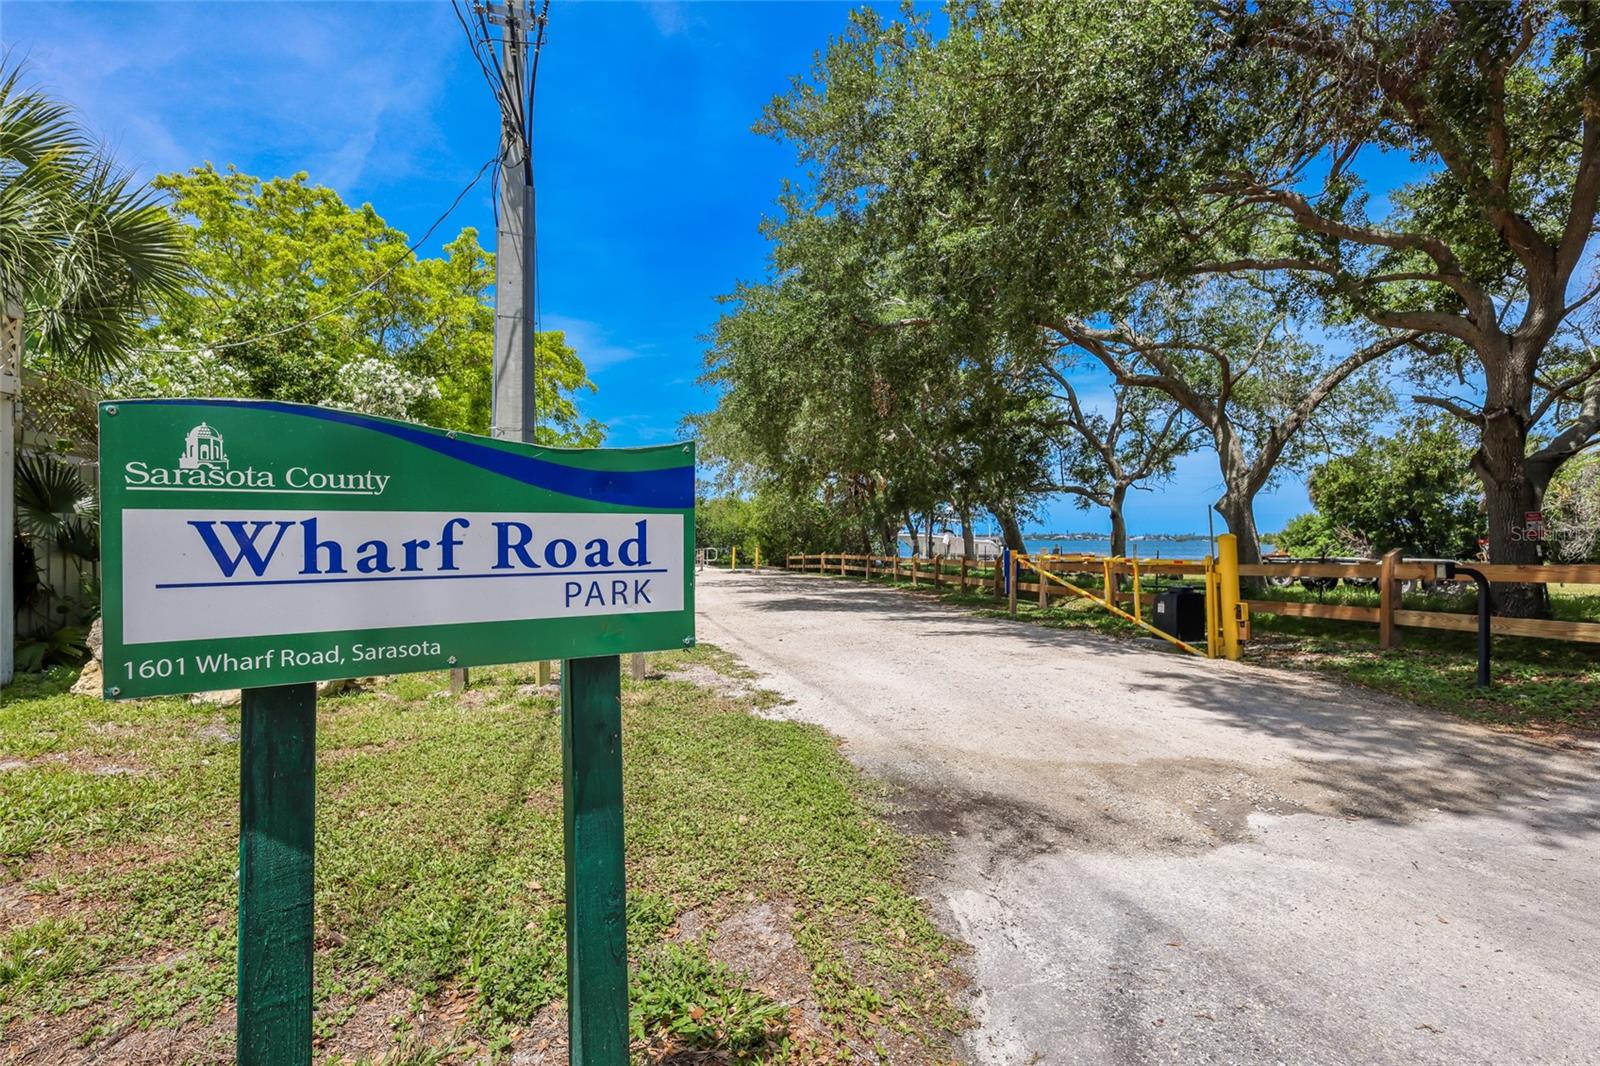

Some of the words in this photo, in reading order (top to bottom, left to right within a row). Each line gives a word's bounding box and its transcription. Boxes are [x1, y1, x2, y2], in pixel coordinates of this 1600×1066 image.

[124, 461, 276, 488] Sarasota
[285, 466, 391, 495] County
[186, 516, 471, 578] Wharf
[491, 519, 652, 570] Road
[565, 579, 652, 608] PARK
[123, 657, 185, 680] 1601
[195, 649, 275, 674] Wharf
[280, 645, 345, 667] Road,
[351, 640, 441, 662] Sarasota
